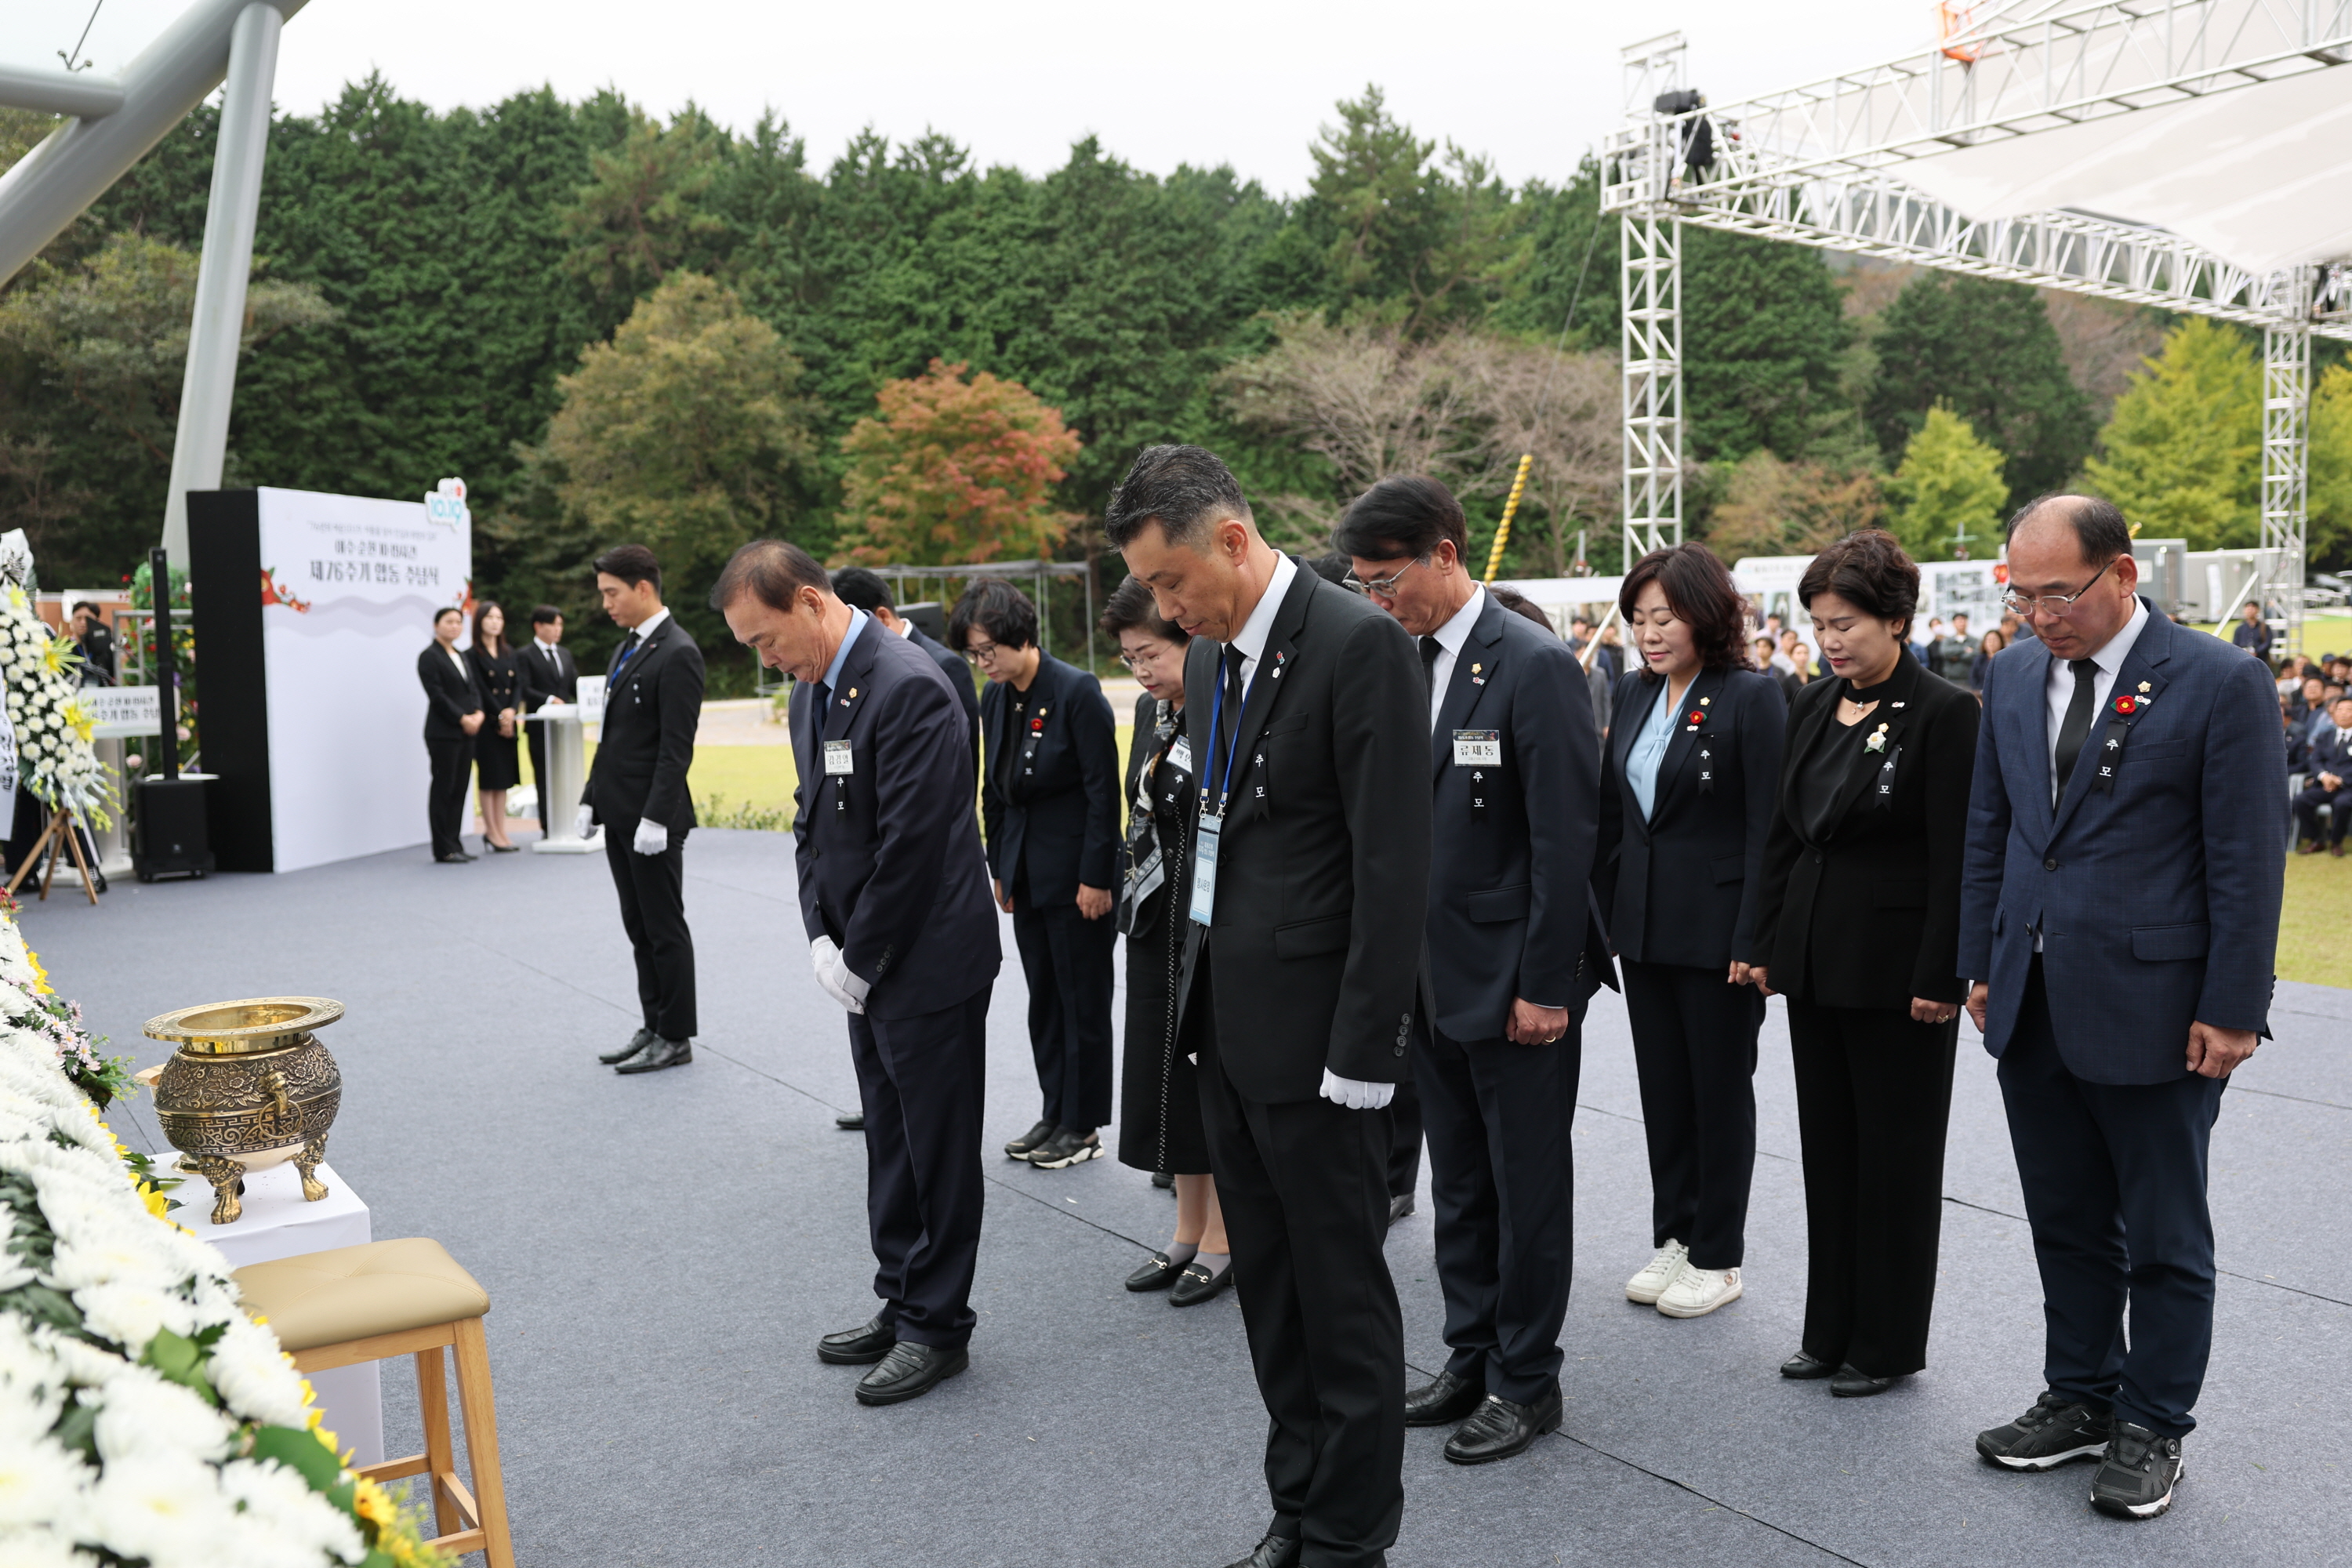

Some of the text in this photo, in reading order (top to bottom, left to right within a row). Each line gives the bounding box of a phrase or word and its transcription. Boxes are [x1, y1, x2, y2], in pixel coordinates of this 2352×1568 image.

[1460, 745, 1494, 756] 류제동
[1700, 750, 1711, 780] 추모
[2099, 739, 2118, 777] 추모
[1254, 754, 1265, 798] 추모
[1473, 771, 1484, 808] 추모
[1879, 761, 1893, 794] 추모
[837, 777, 844, 810] 추모
